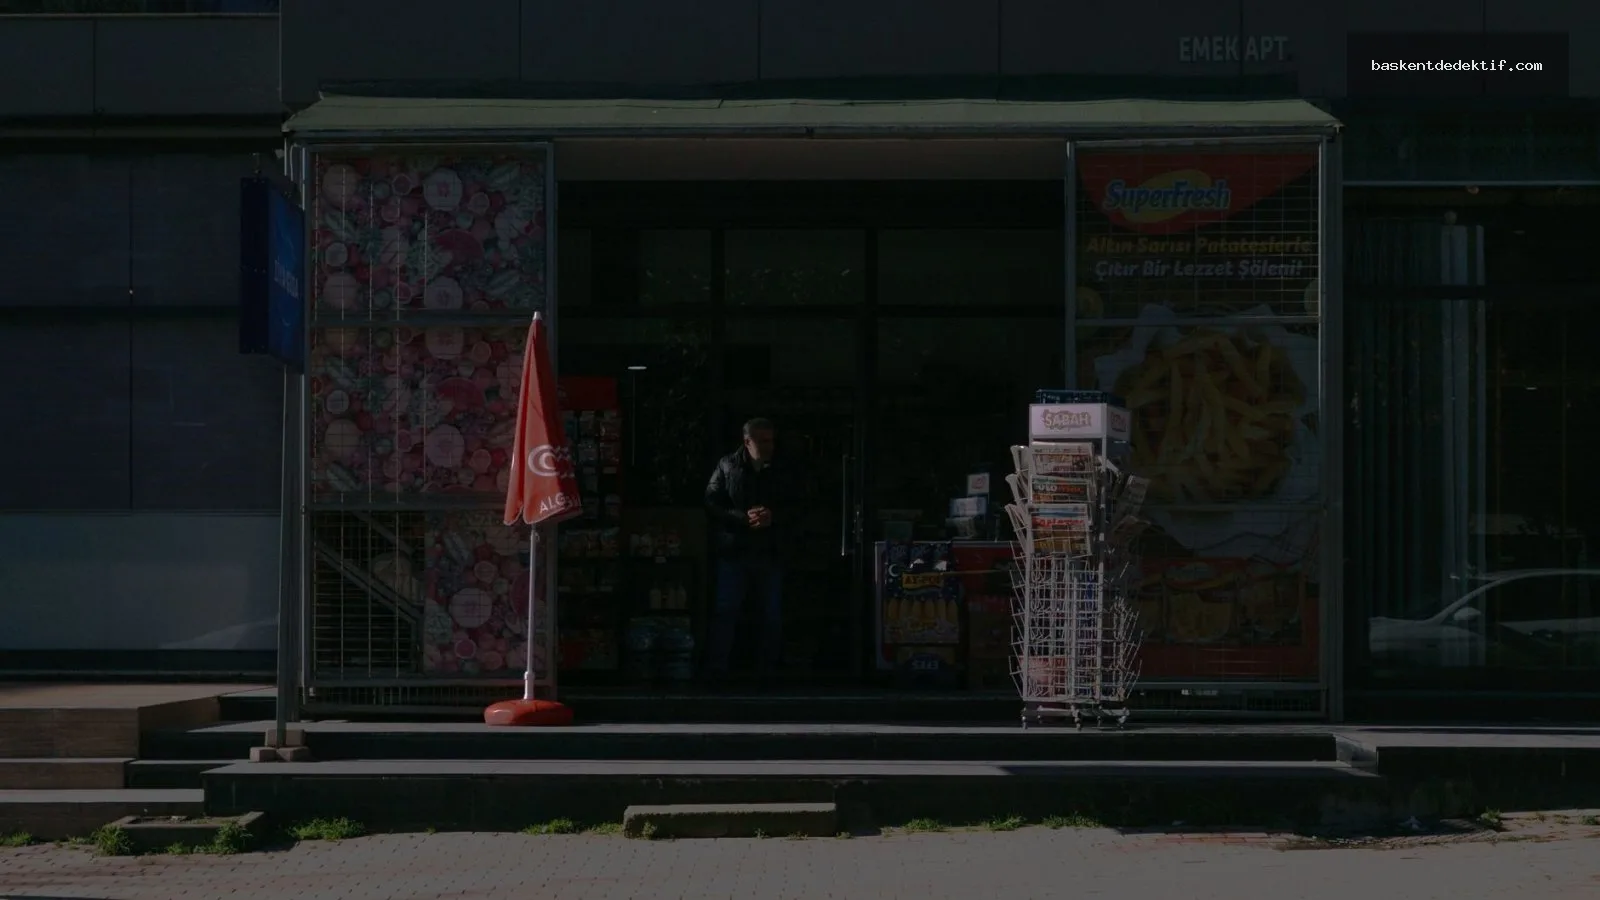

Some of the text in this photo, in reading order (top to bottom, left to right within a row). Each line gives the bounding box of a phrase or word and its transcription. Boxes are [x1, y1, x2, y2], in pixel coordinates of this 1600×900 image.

[1178, 36, 1240, 63] EMEK
[1104, 178, 1232, 212] SuperFresh
[1095, 259, 1303, 280] Çıtır Bir Lezzet Şöleni!
[1045, 412, 1090, 427] SABAH
